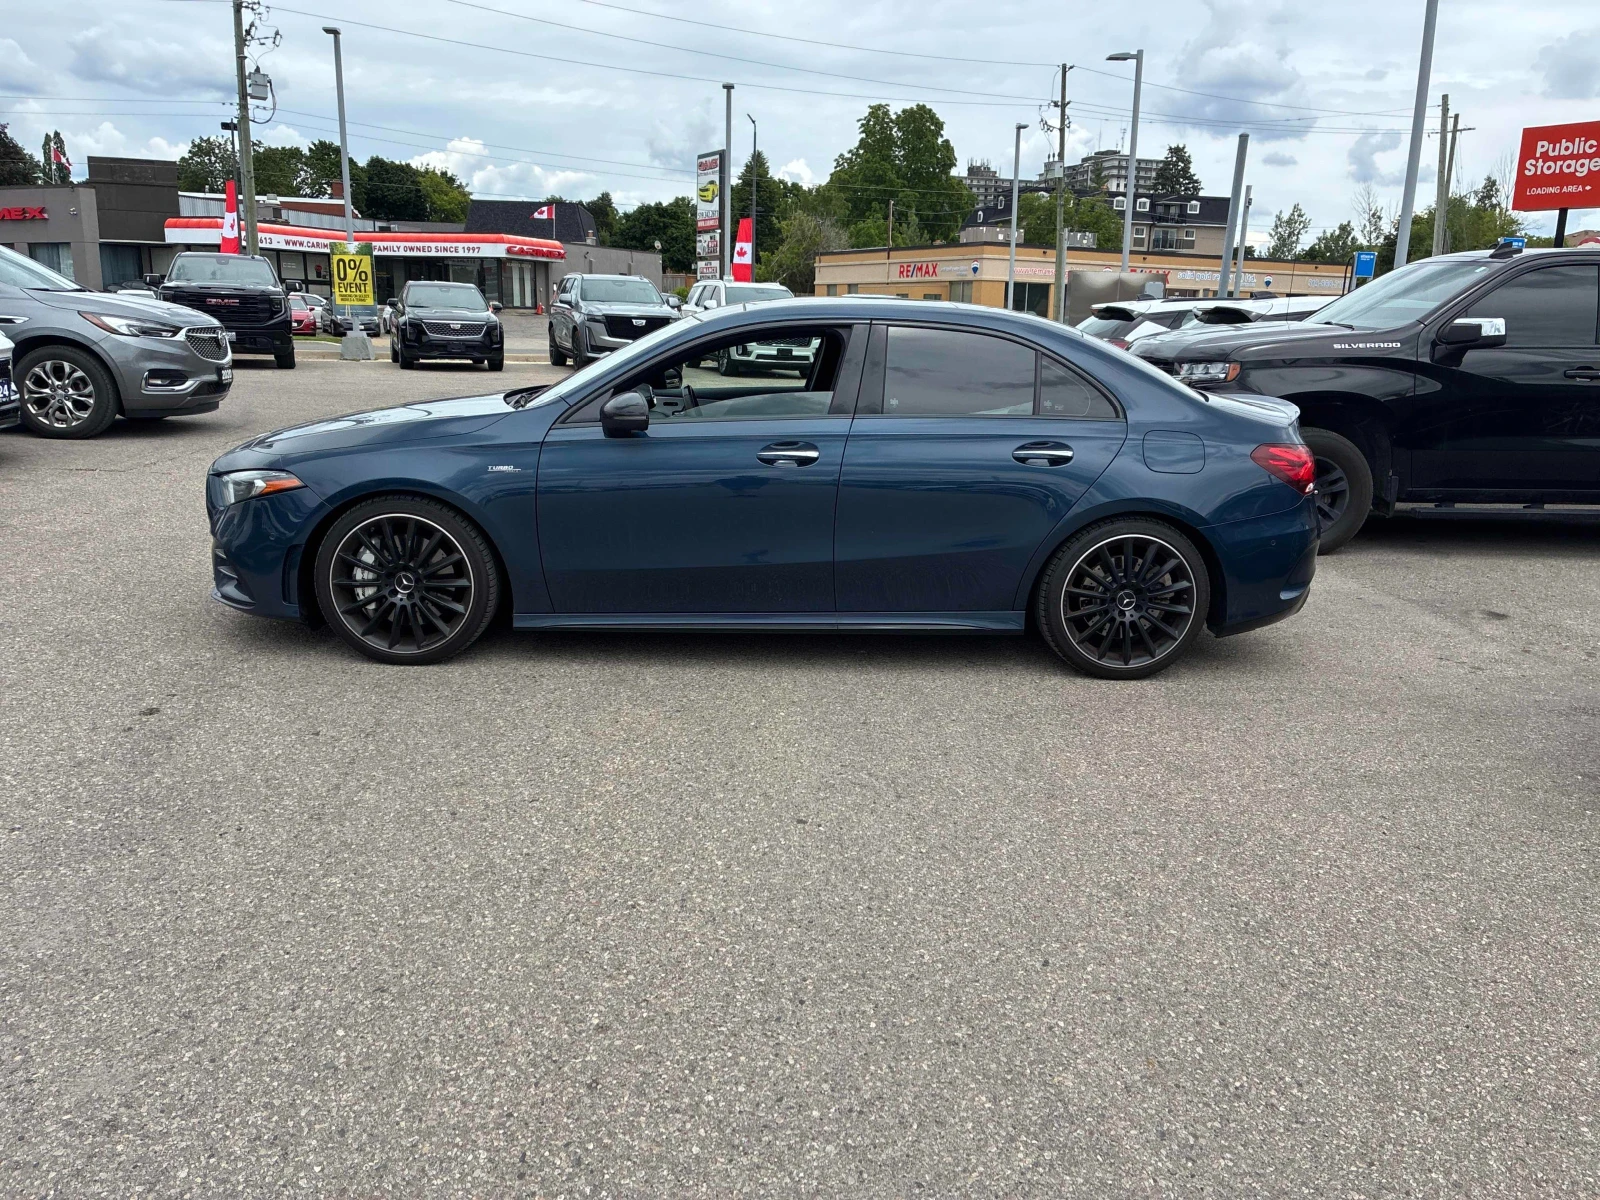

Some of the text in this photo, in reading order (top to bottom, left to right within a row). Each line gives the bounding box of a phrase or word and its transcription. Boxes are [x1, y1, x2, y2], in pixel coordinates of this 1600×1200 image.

[1536, 137, 1598, 157] Public
[1524, 158, 1600, 177] Storage
[1526, 184, 1583, 195] LOADING AREA
[284, 239, 329, 250] WWW.CARIM
[373, 244, 401, 253] FAMILY
[403, 245, 432, 253] OWNED
[434, 246, 460, 254] SINCE
[462, 246, 481, 254] 1997
[505, 245, 567, 259] CARIMEX
[336, 258, 369, 282] 0%
[899, 263, 938, 278] RE/MAX
[1014, 267, 1056, 276] www.remaxs
[1178, 270, 1195, 280] solid
[1196, 271, 1212, 281] gold
[1212, 273, 1233, 283] rey
[338, 282, 368, 293] EVENT
[206, 298, 239, 306] GMC
